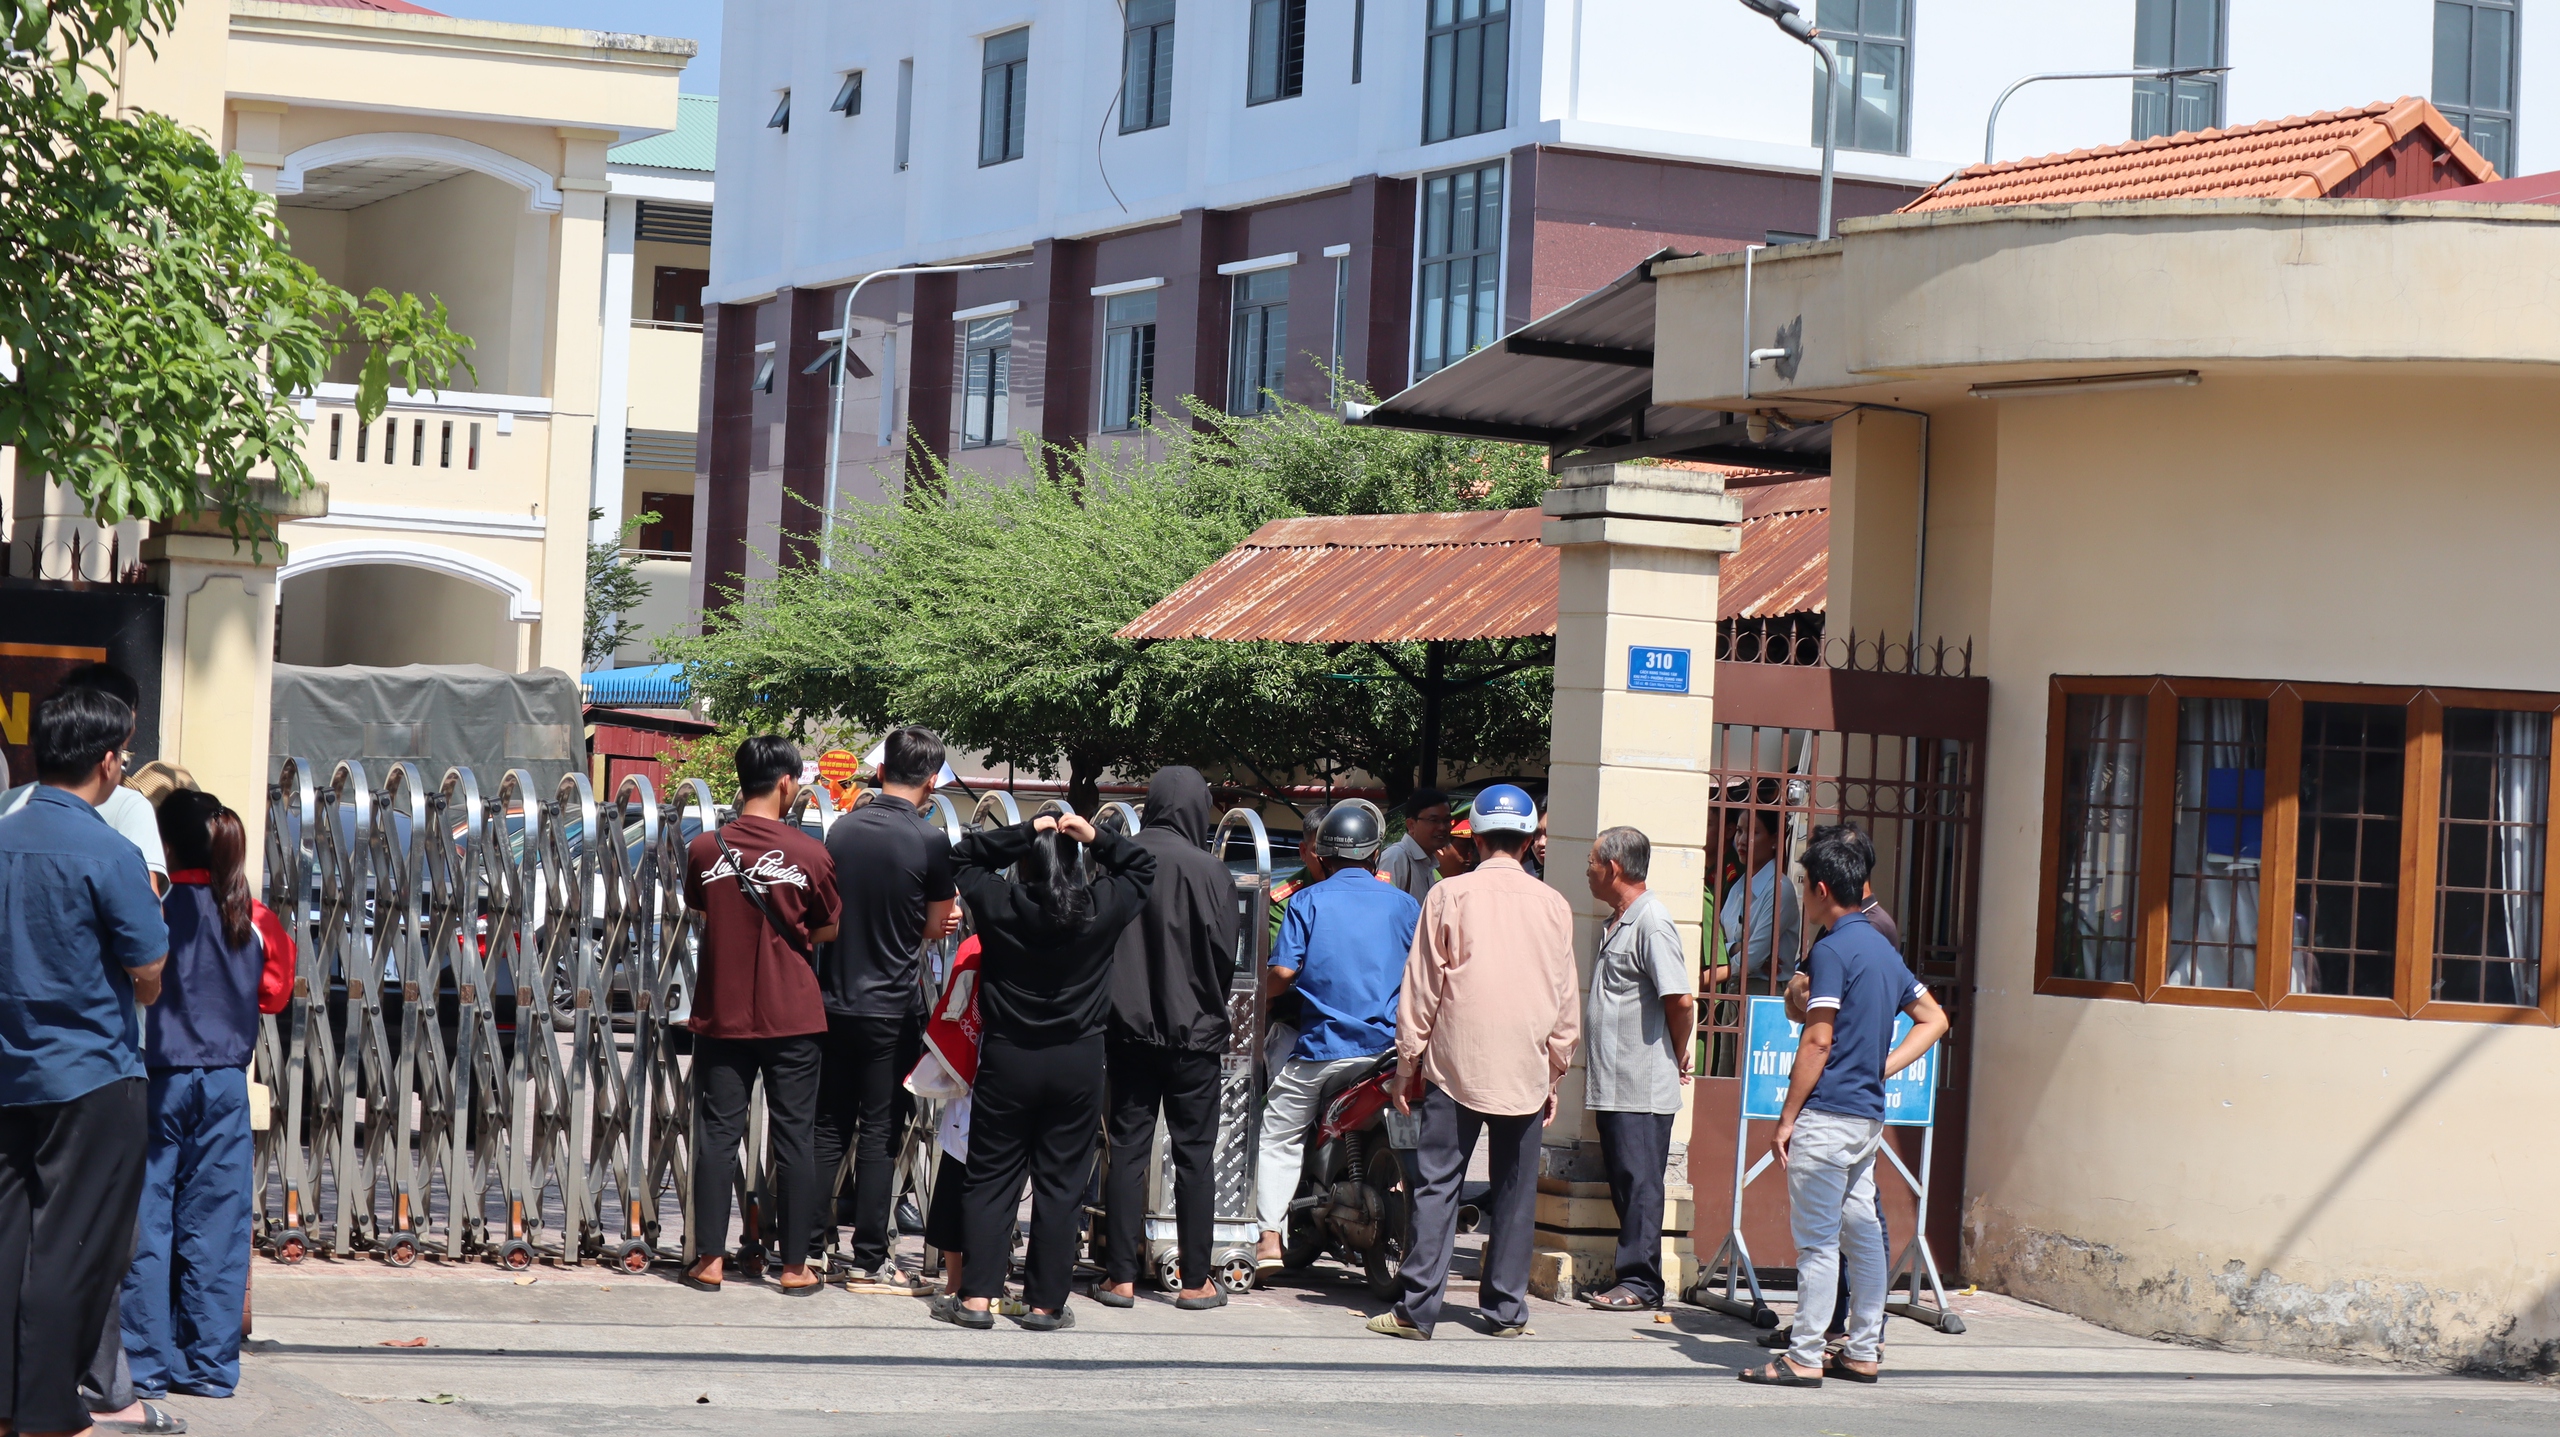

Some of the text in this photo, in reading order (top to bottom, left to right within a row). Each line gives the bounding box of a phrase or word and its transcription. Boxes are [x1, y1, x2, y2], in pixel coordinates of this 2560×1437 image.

[1646, 652, 1672, 670] 310
[1753, 1041, 1777, 1075] TẮT
[1220, 1092, 1230, 1105] ATE
[1238, 1092, 1249, 1104] GATE
[1885, 1088, 1901, 1108] TỜ
[1236, 1112, 1247, 1123] GATE
[1234, 1132, 1245, 1143] GATE
[1232, 1151, 1244, 1163] GATE
[1214, 1172, 1223, 1182] ATE
[1231, 1171, 1242, 1183] GATE
[1229, 1191, 1240, 1202] GATE
